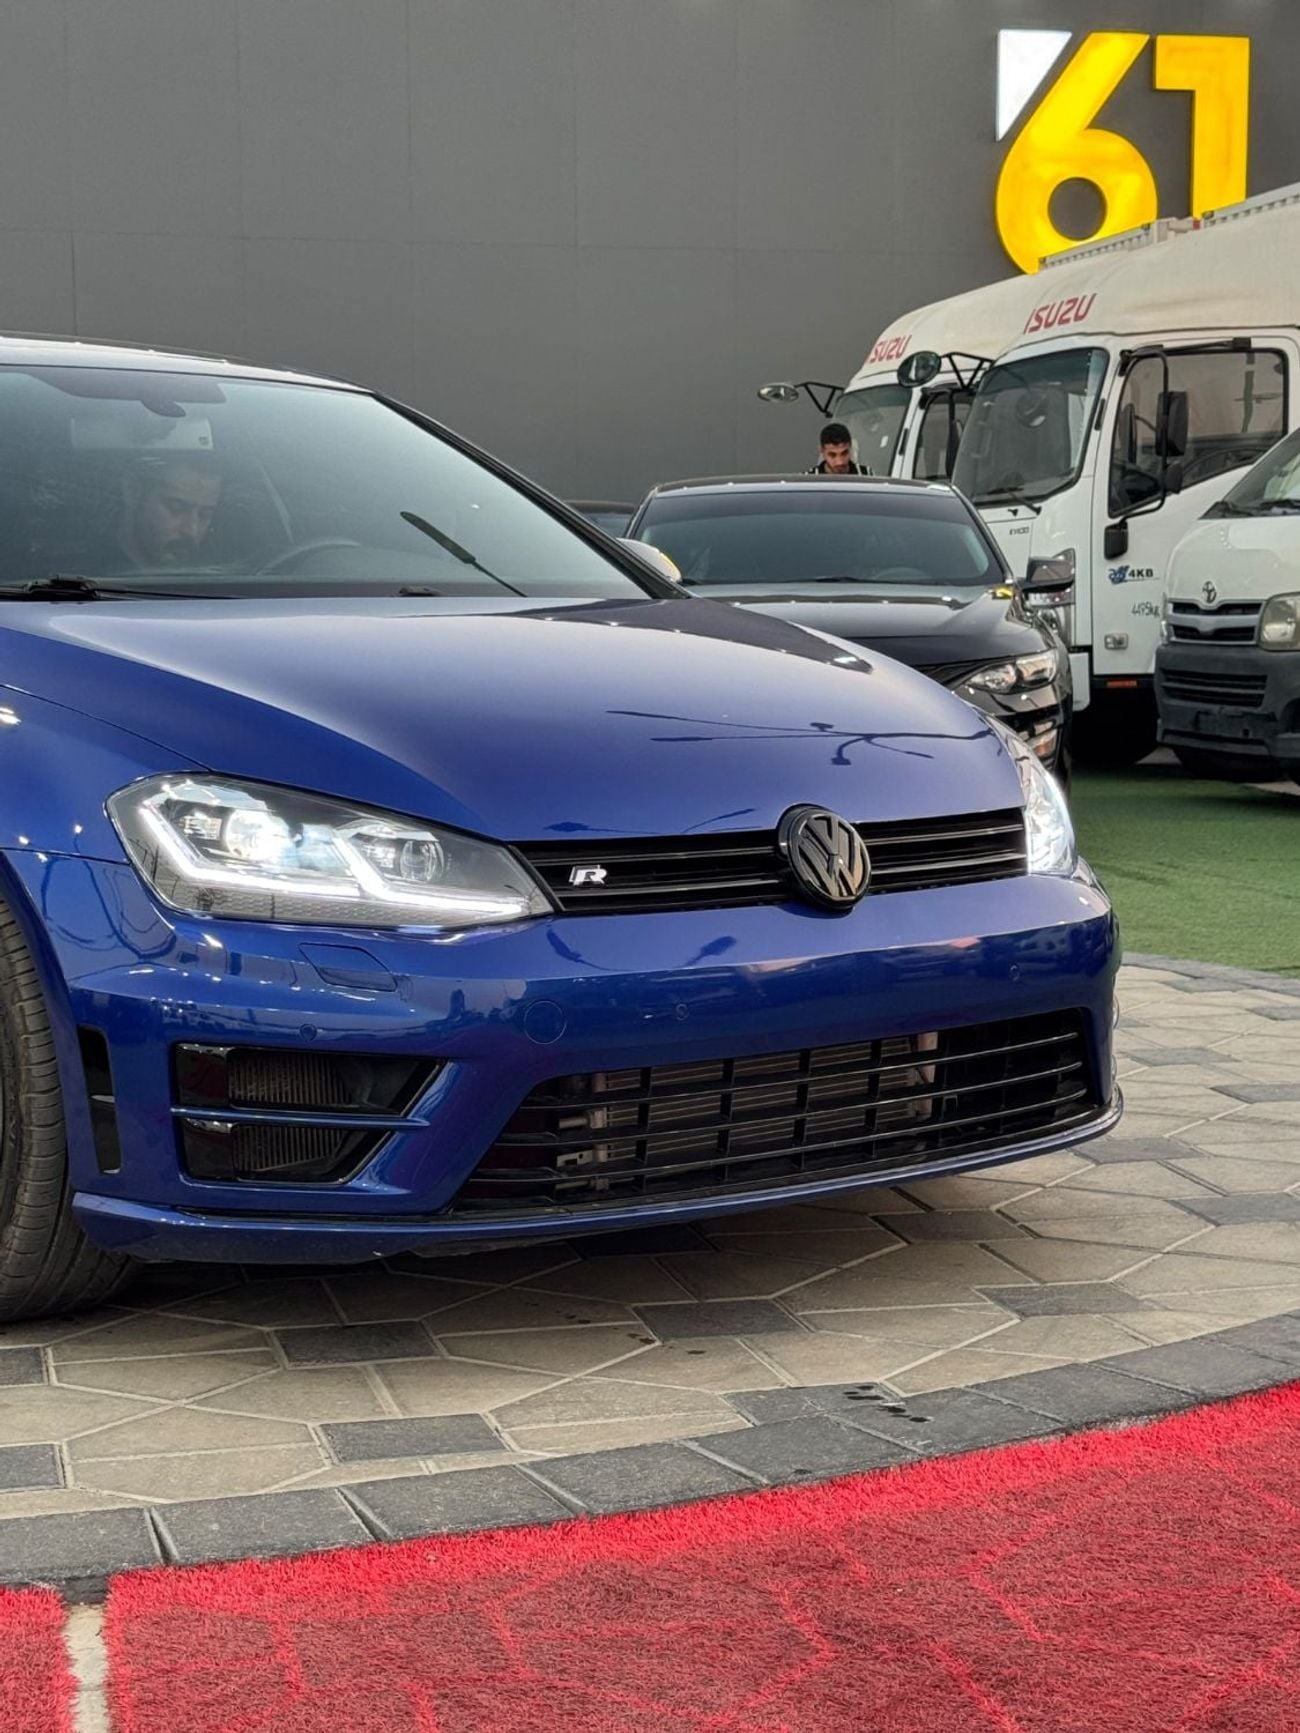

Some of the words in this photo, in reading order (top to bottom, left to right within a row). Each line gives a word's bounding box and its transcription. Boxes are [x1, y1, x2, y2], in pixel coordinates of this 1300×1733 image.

[1023, 292, 1097, 334] ISUZU
[867, 334, 912, 363] SUZU
[569, 864, 608, 887] R
